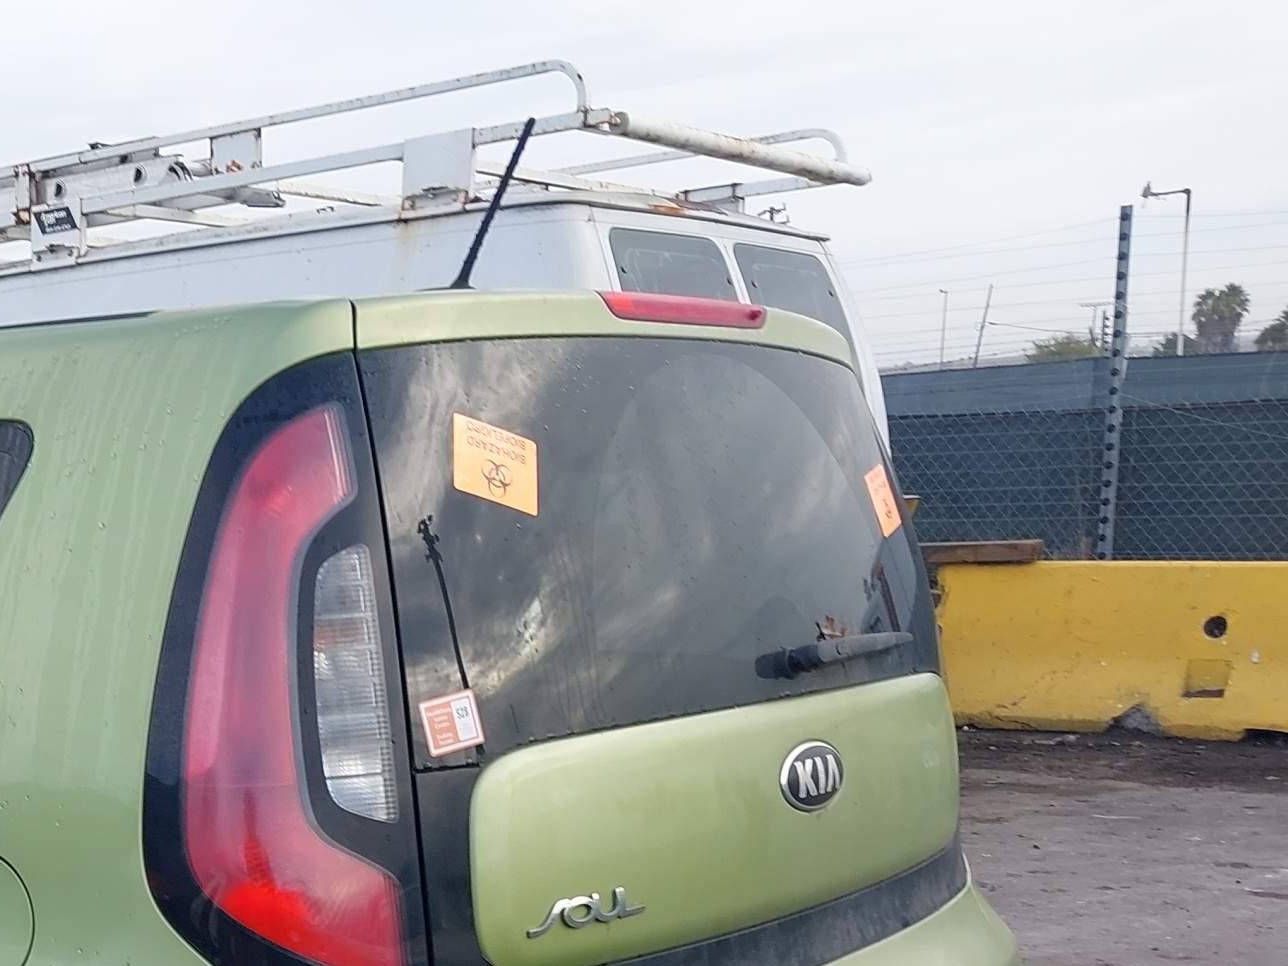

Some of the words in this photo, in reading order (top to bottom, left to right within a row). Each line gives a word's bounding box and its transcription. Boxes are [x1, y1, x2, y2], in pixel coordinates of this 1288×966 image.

[466, 434, 526, 465] BIOHAZARD
[793, 754, 841, 799] KIA
[526, 886, 646, 939] SOUL
